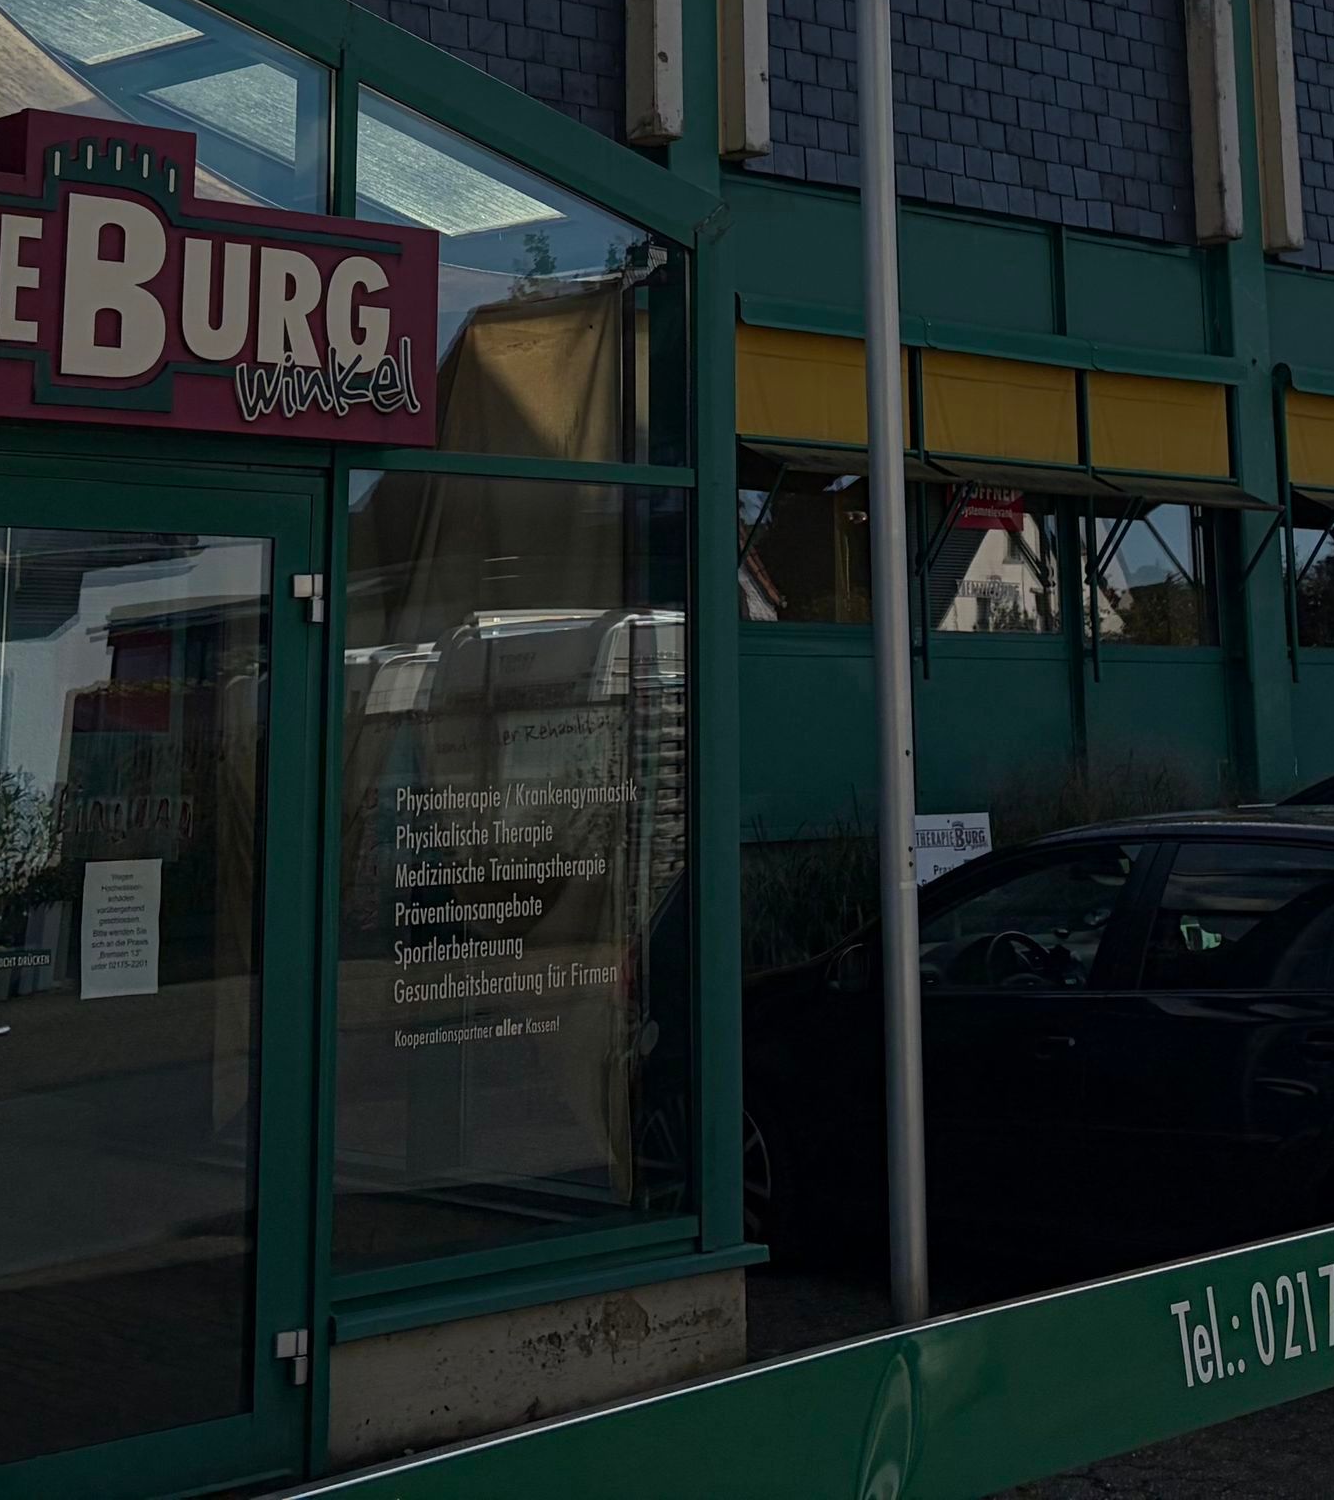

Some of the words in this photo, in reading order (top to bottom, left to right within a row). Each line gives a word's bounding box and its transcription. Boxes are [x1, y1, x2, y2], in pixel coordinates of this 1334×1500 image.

[234, 334, 421, 423] winkel
[396, 783, 502, 818] Physiotherapie
[515, 778, 638, 813] Krankengymnastik
[396, 825, 489, 856] Physikalische
[493, 820, 554, 850] Therapie
[395, 858, 486, 889] Medizinische
[490, 853, 606, 885] Trainingstherapie
[395, 895, 543, 927] Präventionsangebote
[17, 953, 50, 967] DRÜCKEN
[394, 934, 524, 967] Sportlerbetreuung
[393, 971, 544, 1005] Gesundheitsberatung
[546, 968, 567, 990] für
[571, 963, 619, 987] Firmen
[394, 1024, 494, 1049] Kooperationspartner
[495, 1019, 524, 1037] aller
[525, 1015, 561, 1035] Kassen!
[1170, 1285, 1247, 1388] Tel.:
